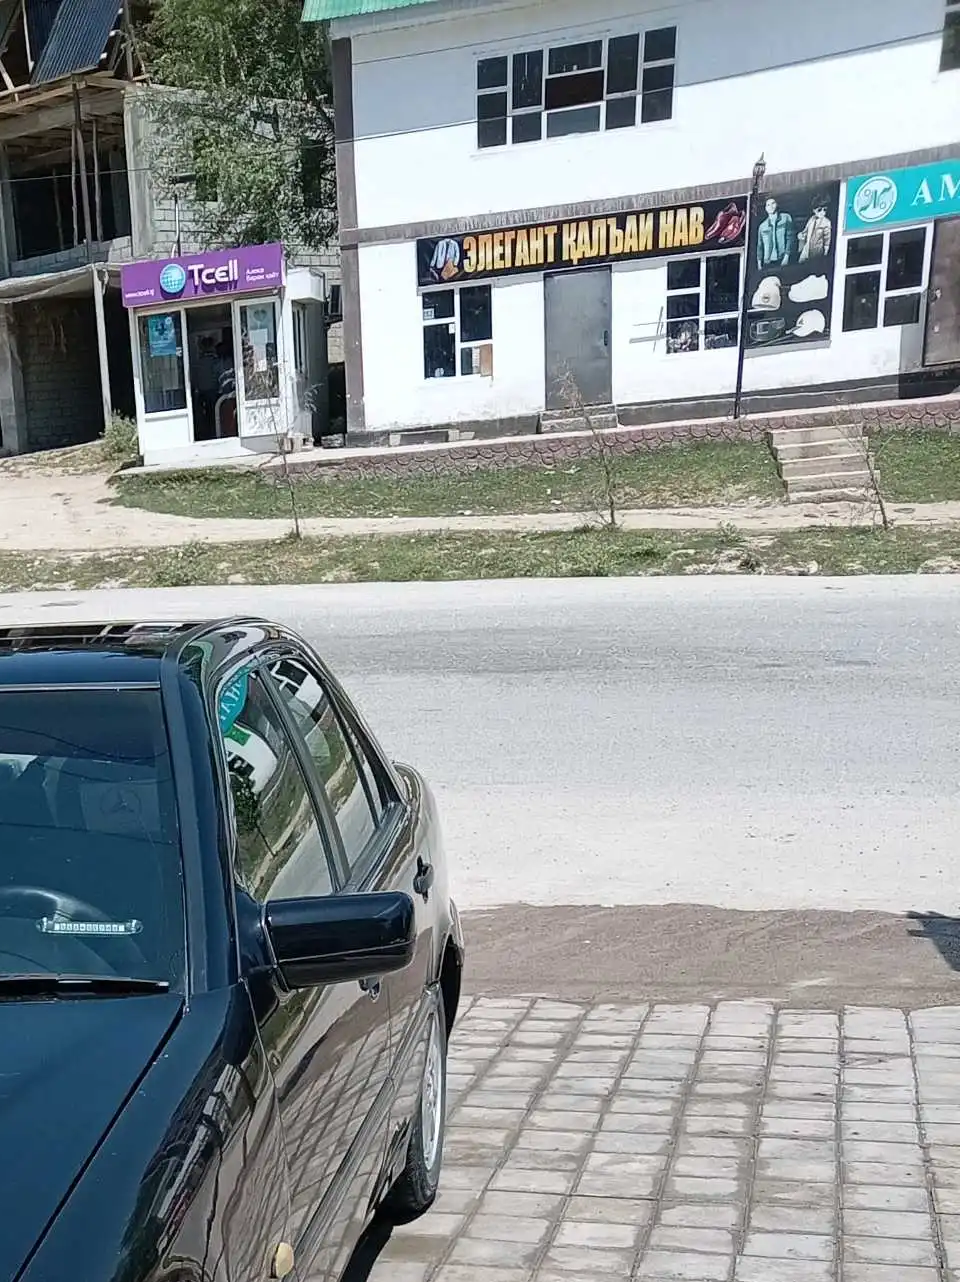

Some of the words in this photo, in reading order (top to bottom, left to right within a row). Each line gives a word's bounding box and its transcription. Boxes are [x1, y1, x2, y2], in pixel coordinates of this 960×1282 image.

[463, 225, 559, 273] ЭЛЕГАНТ
[659, 206, 705, 249] НАВ
[187, 259, 238, 286] Tcell
